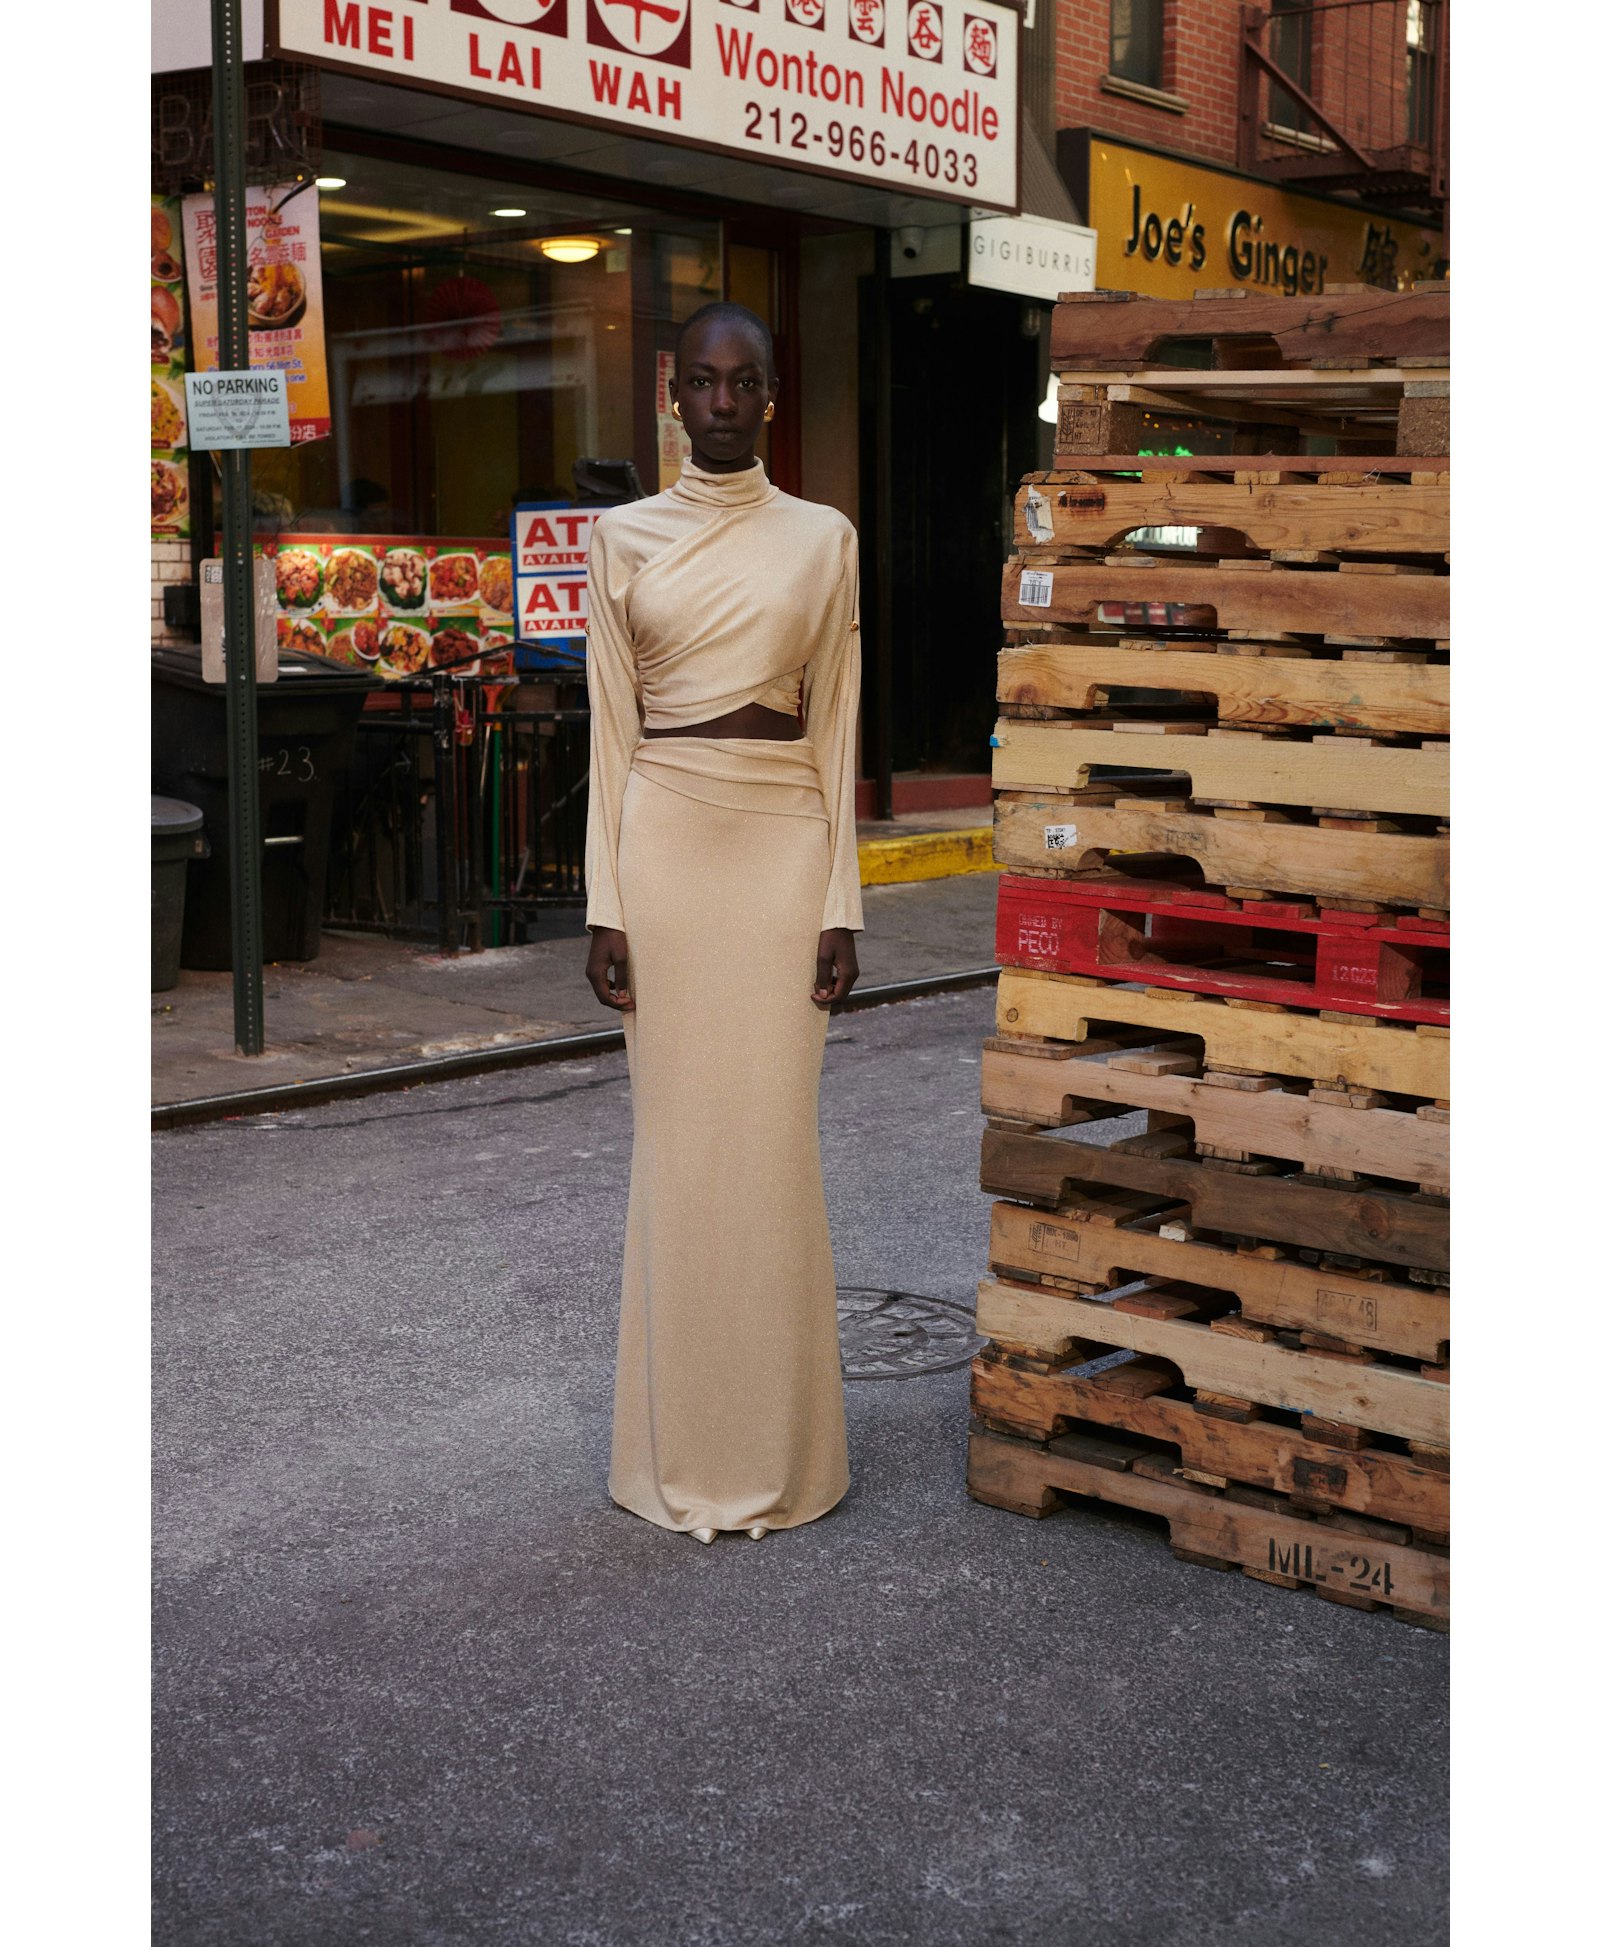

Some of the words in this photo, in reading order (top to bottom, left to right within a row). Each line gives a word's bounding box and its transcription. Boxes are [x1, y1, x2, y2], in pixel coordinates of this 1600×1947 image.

[324, 0, 414, 61] MEI
[469, 33, 542, 90] LAI
[588, 59, 682, 121] WAH
[715, 23, 864, 108] Wonton
[881, 66, 999, 141] Noodle
[745, 102, 978, 187] 212-966-4033
[1125, 184, 1206, 271] Joe's
[1228, 209, 1328, 297] Ginger
[193, 380, 213, 395] NO
[217, 377, 279, 394] PARKING
[523, 515, 600, 548] AT
[525, 582, 587, 613] AT
[258, 746, 315, 782] #23
[1018, 929, 1060, 956] PECO
[1268, 1537, 1395, 1596] ML-24
